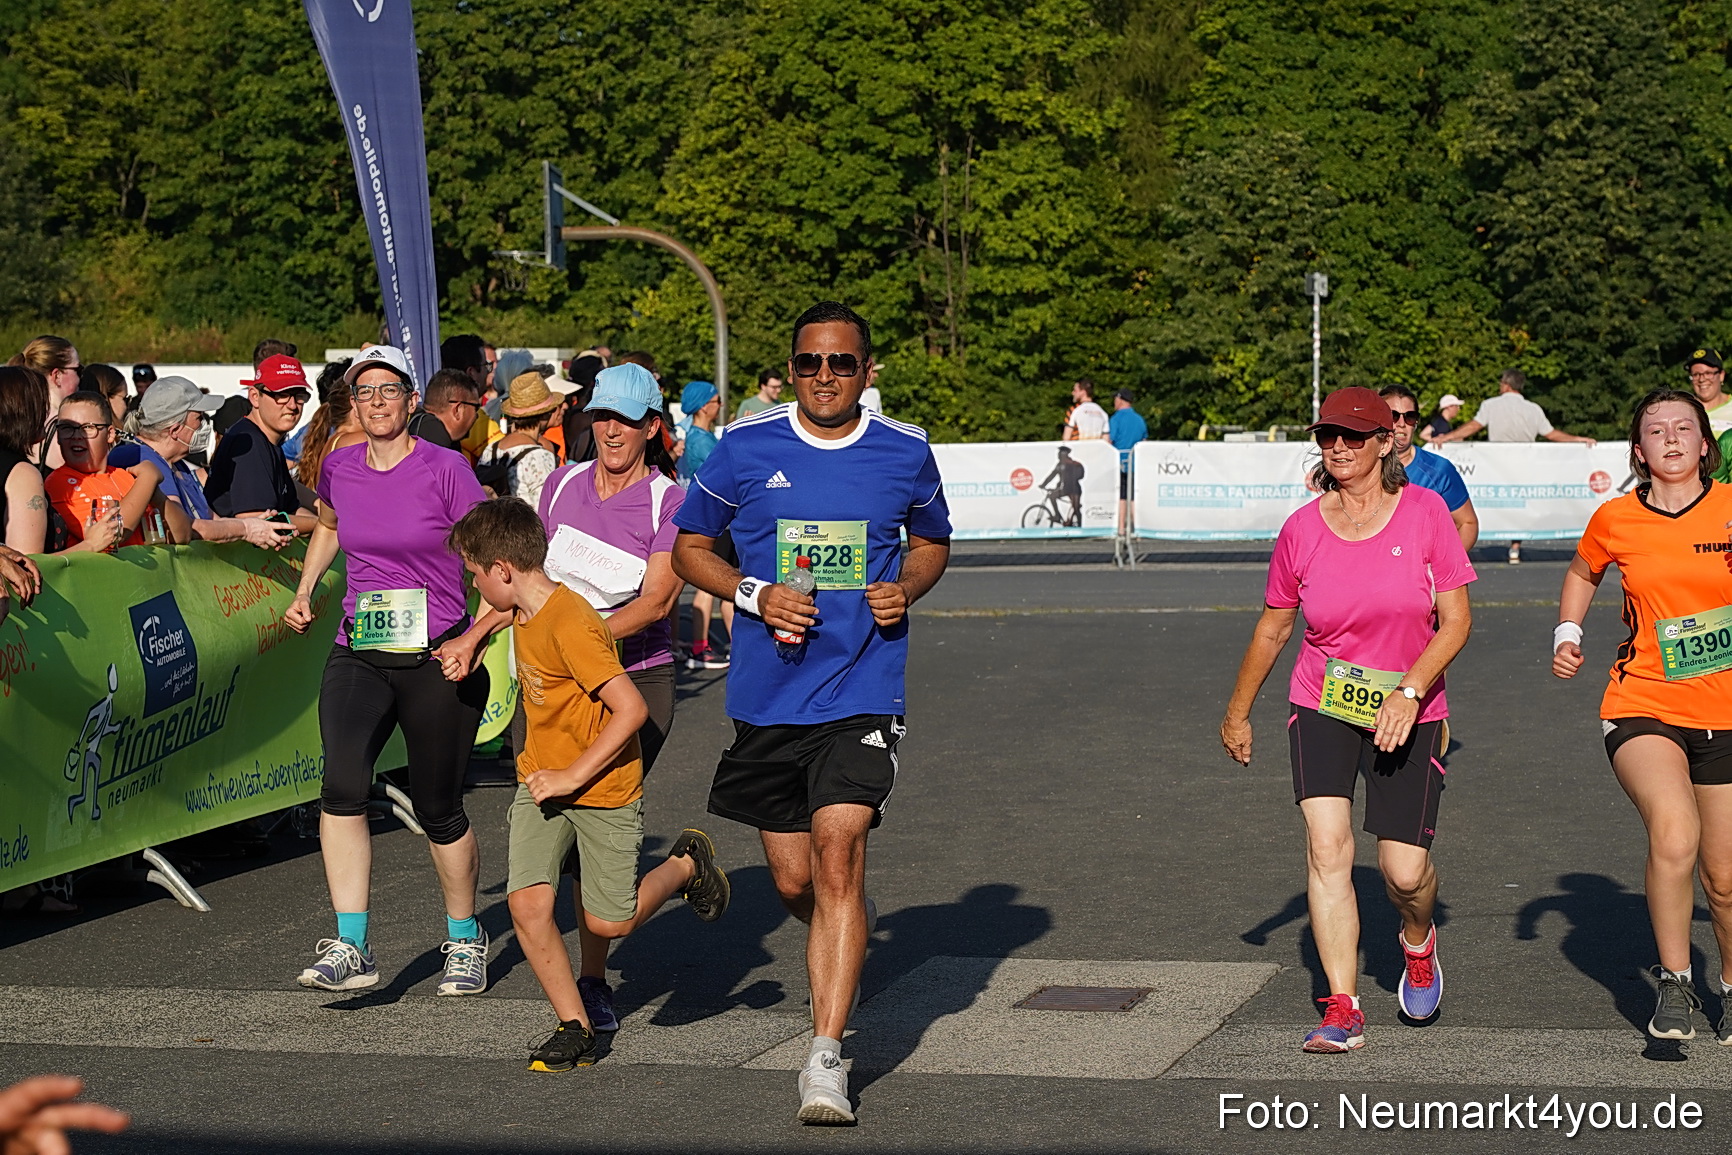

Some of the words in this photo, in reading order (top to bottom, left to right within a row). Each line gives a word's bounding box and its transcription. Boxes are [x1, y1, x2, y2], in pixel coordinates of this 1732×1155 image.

[1158, 462, 1193, 475] NOW
[766, 481, 791, 489] adidas
[1160, 485, 1212, 498] E-BIKES
[1215, 485, 1225, 498] &
[1498, 486, 1508, 498] &
[1511, 484, 1590, 498] FAHRRÄDER
[564, 540, 624, 576] MOTIVATOR
[781, 550, 790, 574] RUN
[792, 544, 853, 568] 1628
[854, 548, 863, 580] 2022
[213, 564, 271, 618] Gesunde
[363, 610, 414, 630] 1883
[148, 628, 185, 657] Fischer
[364, 631, 384, 639] Krebs
[385, 630, 412, 638] Andrea
[1675, 627, 1732, 659] 1390
[156, 647, 187, 668] AUTOMOBILE
[1665, 647, 1677, 669] RUN
[1678, 658, 1708, 668] Endres
[1324, 679, 1336, 708] WALK
[1342, 683, 1384, 710] 899
[1332, 699, 1354, 713] Hillert
[110, 664, 241, 781] firmenlauf
[861, 737, 888, 749] adidas
[107, 763, 164, 810] neumarkt
[185, 743, 326, 814] www.firmenlauf-oberpfalz.d
